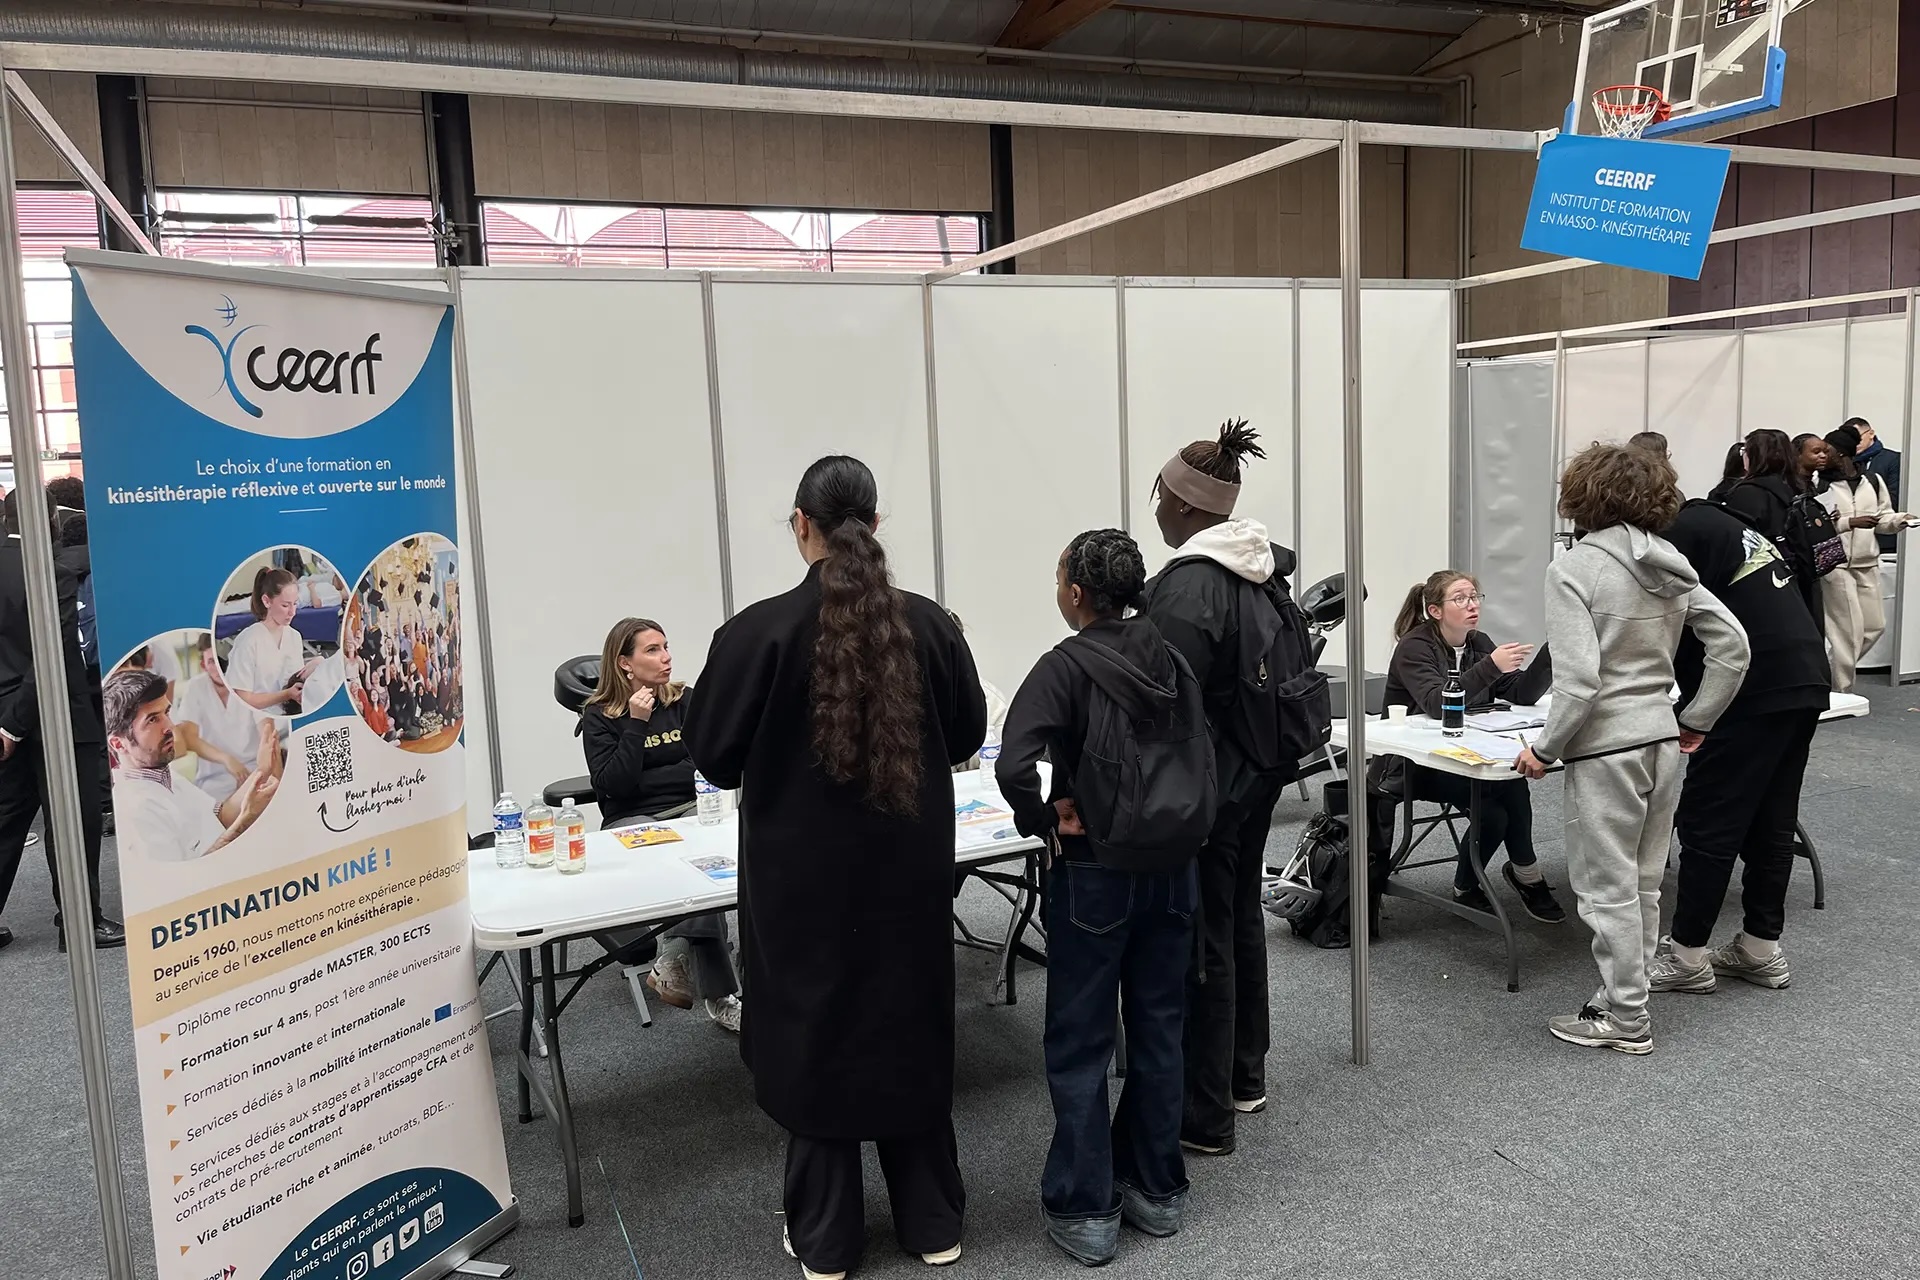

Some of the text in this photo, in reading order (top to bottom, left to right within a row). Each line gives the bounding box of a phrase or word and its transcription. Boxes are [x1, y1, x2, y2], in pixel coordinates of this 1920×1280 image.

[1540, 210, 1692, 246] EN MASSO- KINÉSITHÉRAPIE
[1550, 192, 1691, 224] INSTITUT DE FORMATION
[1595, 168, 1656, 191] CEERRF
[108, 474, 446, 504] kinésithérapie réflexive et ouverte sur le monde
[196, 456, 391, 476] Le choix d'une formation en
[345, 789, 368, 802] Pour
[371, 781, 394, 798] plus
[346, 794, 405, 820] flashez-moi
[151, 847, 392, 950] DESTINATION KINÉ !
[153, 955, 200, 982] Depuis
[202, 940, 240, 960] 1960,
[242, 929, 274, 948] nous
[276, 912, 324, 936] mettons
[327, 898, 356, 917] notre
[358, 877, 416, 904] expérience
[155, 989, 171, 1002] au
[174, 969, 219, 994] service
[223, 960, 240, 974] de
[244, 932, 317, 967] l'excellence
[320, 925, 334, 938] en
[337, 895, 414, 932] kinésithérapie
[177, 924, 431, 1036] Diplôme reconnu grade MASTER, 300 ECTS
[180, 944, 461, 1072] Formation sur 4 ans, post 1ère année universitaire
[184, 997, 406, 1106] Formation innovante et internationale
[186, 1017, 431, 1142] Services dédiés à la mobilité internationale
[174, 1042, 474, 1204] vos recherches de contrats d'apprentissage CFA et de
[190, 1144, 242, 1177] Services
[245, 1122, 286, 1148] dédiés
[290, 1111, 309, 1126] aux
[312, 1090, 348, 1115] stages
[350, 1082, 361, 1096] et
[364, 1077, 370, 1088] à
[372, 1032, 466, 1084] l'accompagnement
[176, 1126, 344, 1223] contrats de pré-recrutement
[197, 1229, 218, 1246] Vie
[222, 1193, 283, 1232] étudiante
[286, 1174, 314, 1198] riche
[318, 1165, 330, 1179] et
[334, 1143, 376, 1172] animée,
[378, 1117, 420, 1145] tutorats,
[295, 1180, 418, 1262] Le CEERRF, ce sont ses
[283, 1258, 320, 1280] diants
[322, 1246, 340, 1263] qui
[342, 1237, 356, 1249] en
[358, 1211, 394, 1244] parlent
[396, 1204, 406, 1216] le
[408, 1185, 438, 1209] mieux
